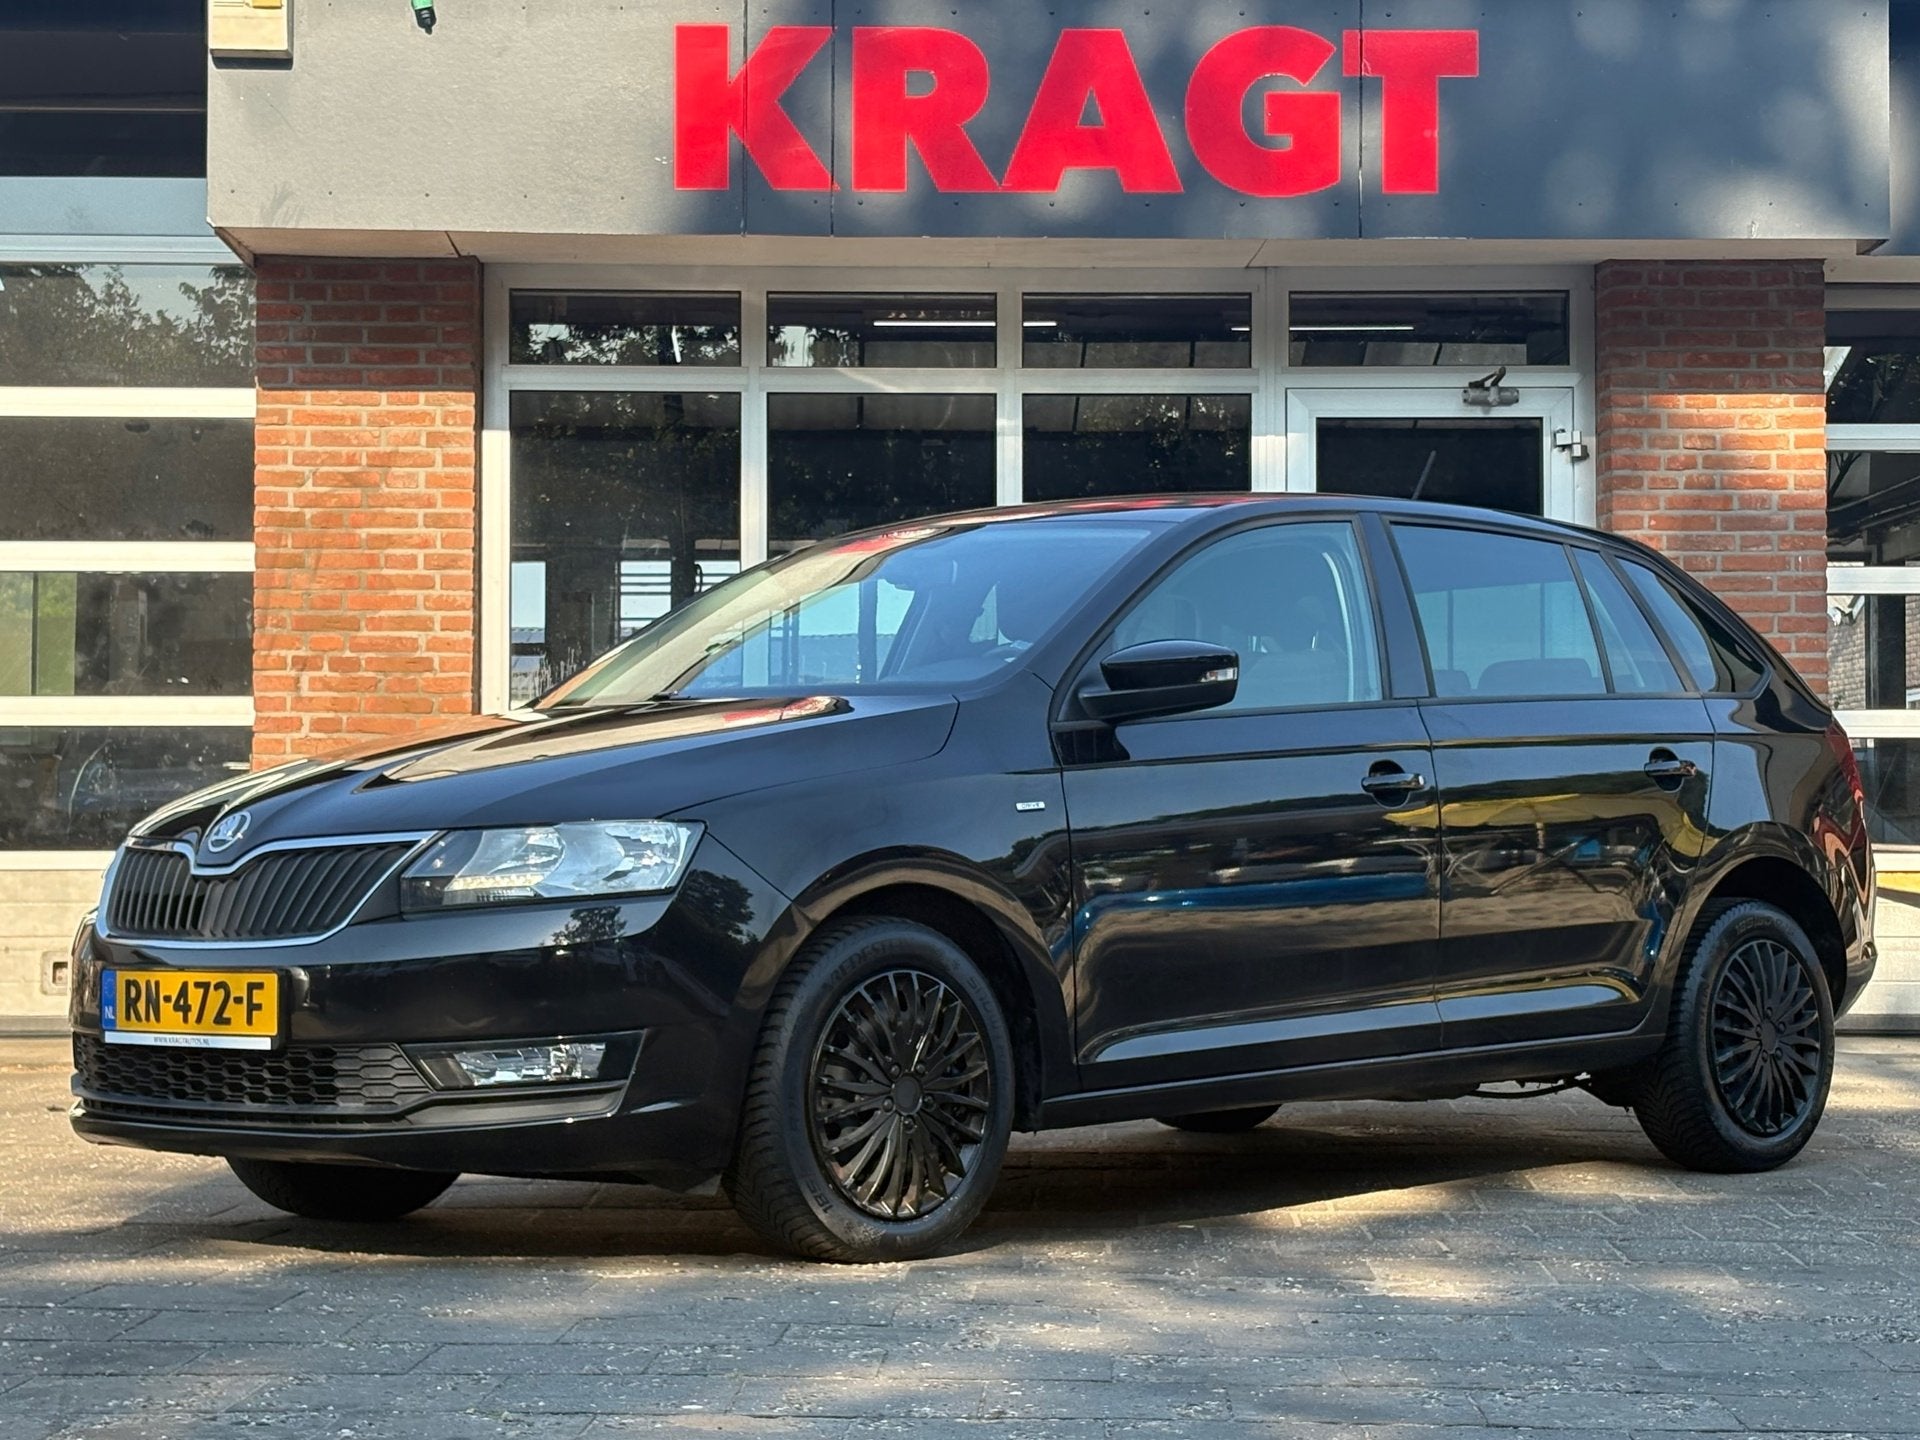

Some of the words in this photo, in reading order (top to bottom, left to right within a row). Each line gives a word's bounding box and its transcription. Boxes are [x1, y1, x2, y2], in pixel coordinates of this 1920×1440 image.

[673, 24, 1480, 198] KRAGT
[104, 1005, 115, 1020] NL
[124, 979, 265, 1026] RN-472-F
